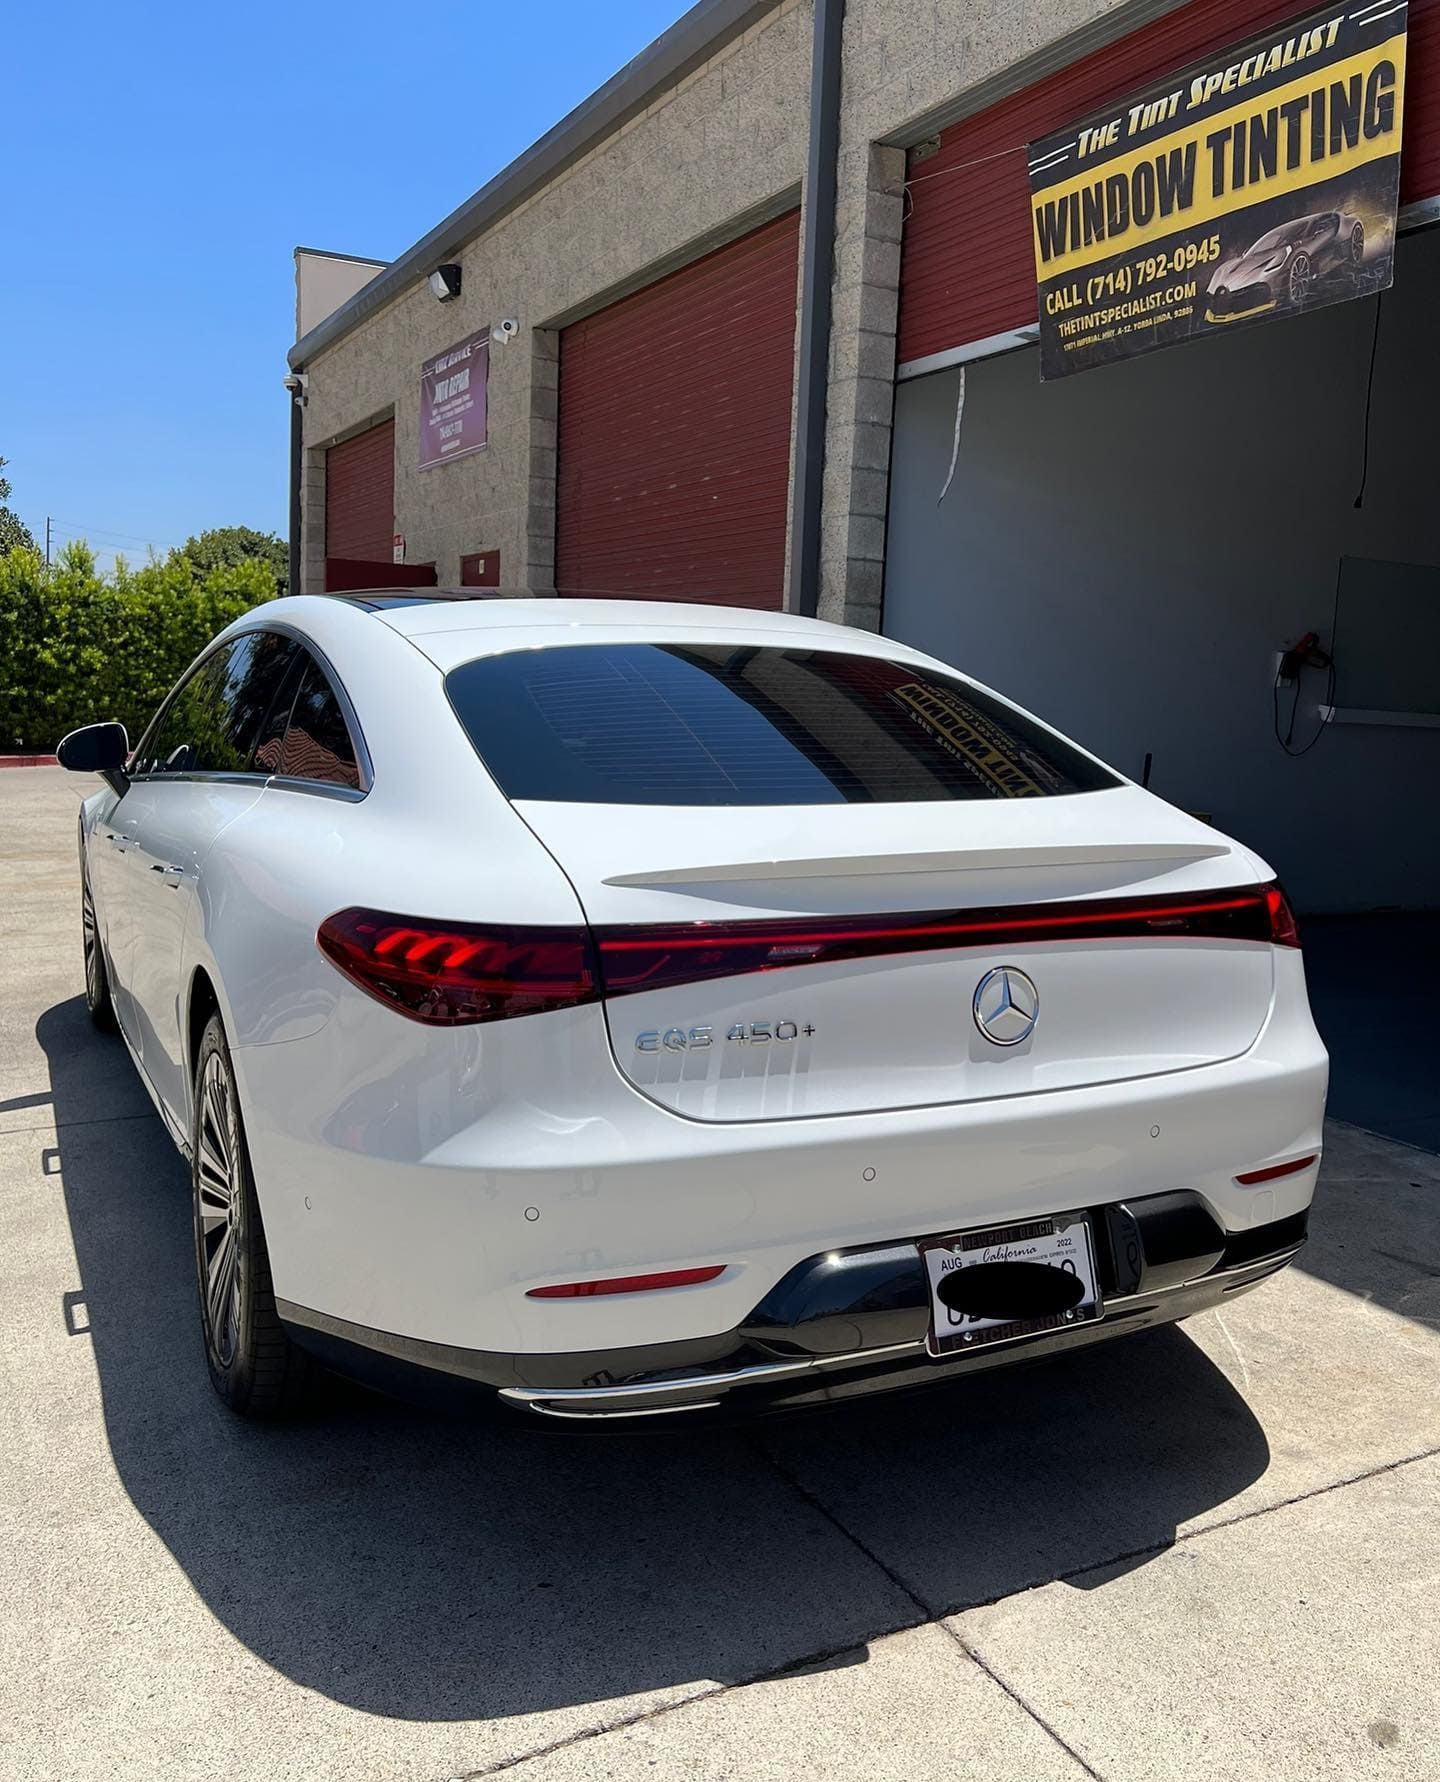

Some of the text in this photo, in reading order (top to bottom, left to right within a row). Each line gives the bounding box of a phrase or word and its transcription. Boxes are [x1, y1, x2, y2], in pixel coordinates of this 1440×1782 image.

[1078, 118, 1122, 159] THE
[1186, 15, 1346, 111] SPECIALIST
[1035, 60, 1396, 263] WINDOW TINTING
[1046, 234, 1221, 315] CALL (714) 792-0945
[1058, 281, 1197, 338] THETINTSPECIALIST.COM
[635, 1020, 816, 1053] EQS 450+
[963, 1221, 1054, 1249] NEWPORT BEACH
[1057, 1238, 1072, 1248] 2022
[941, 1257, 963, 1272] AUG
[982, 1246, 1038, 1262] California
